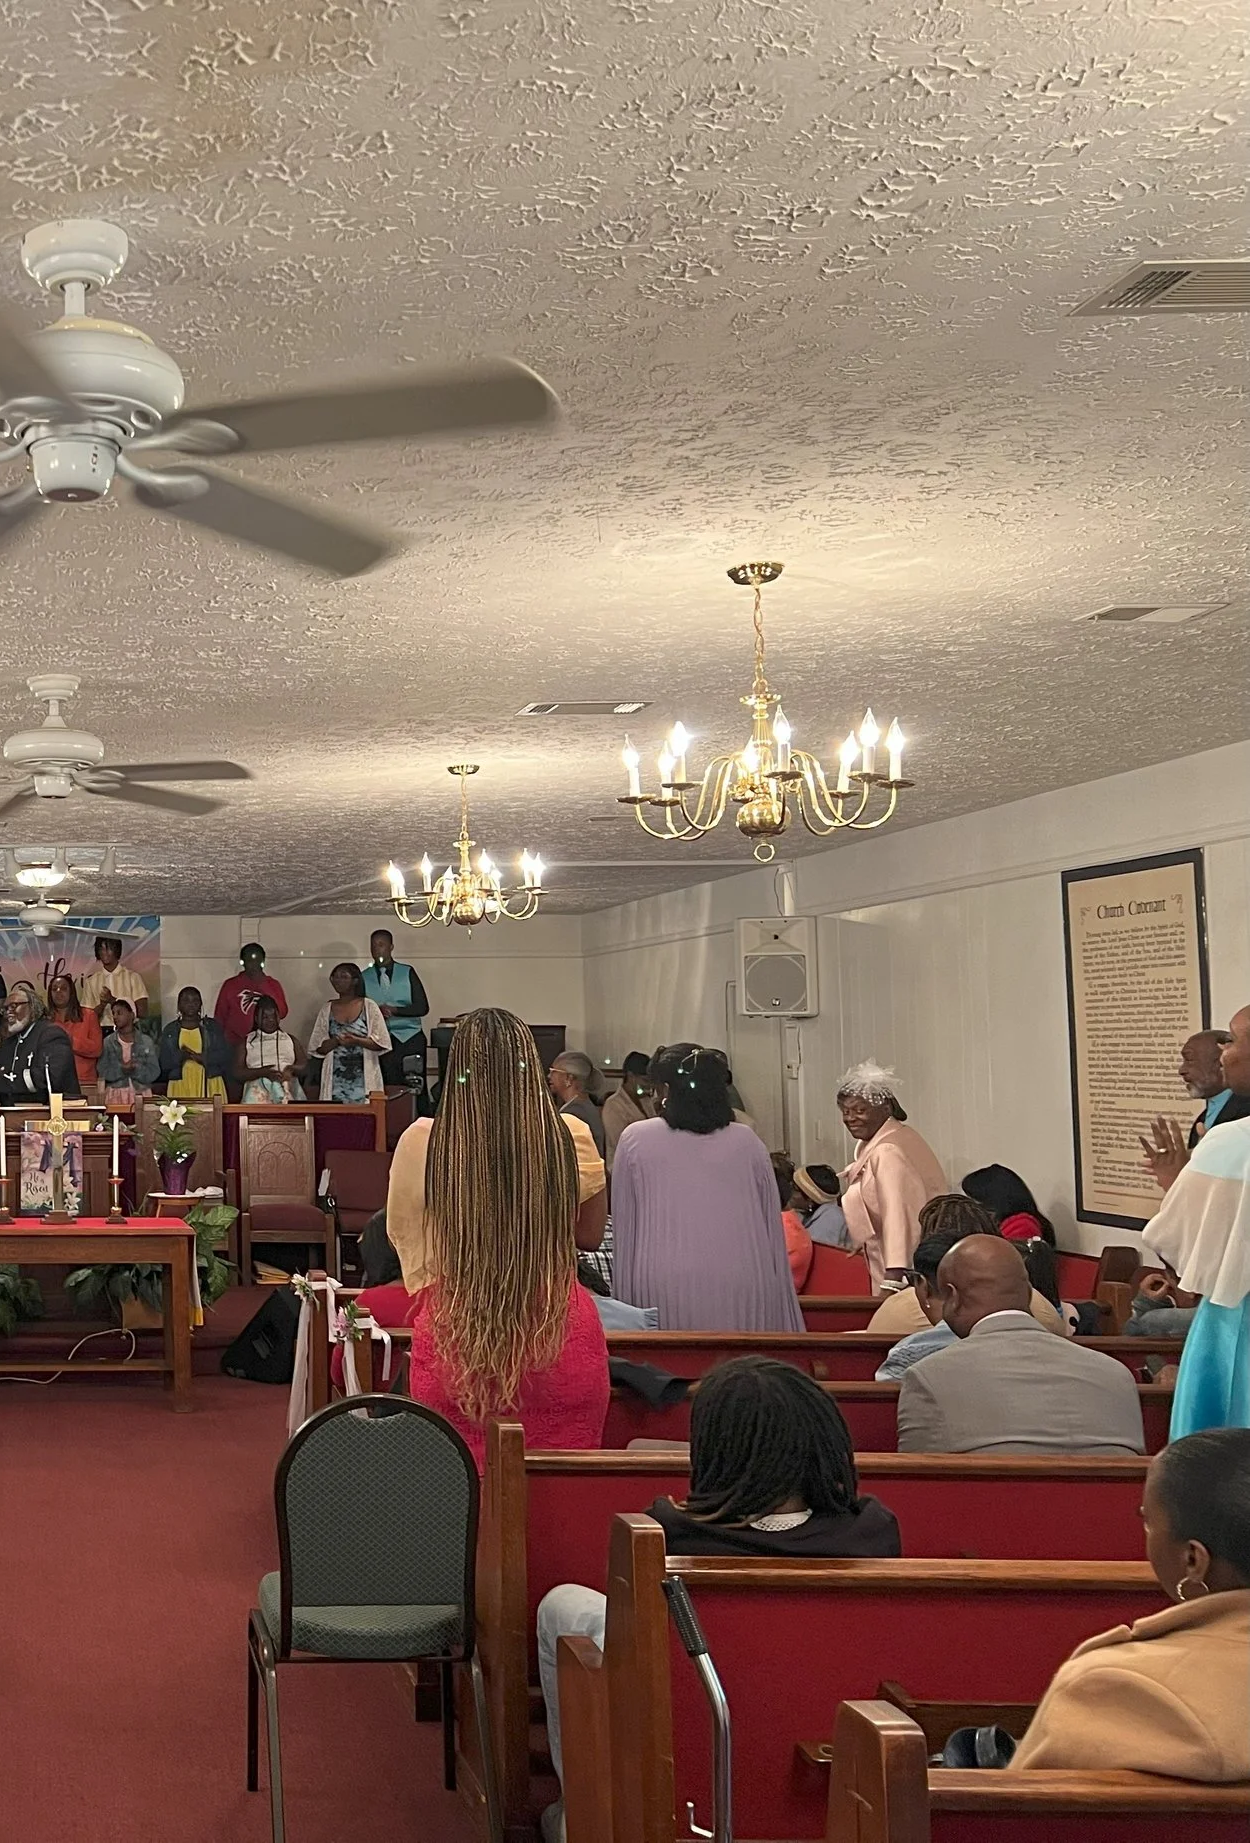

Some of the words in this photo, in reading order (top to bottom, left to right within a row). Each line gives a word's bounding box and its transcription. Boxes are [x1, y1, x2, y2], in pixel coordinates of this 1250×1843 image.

[1096, 903, 1125, 919] Church
[1128, 900, 1166, 916] Covenant
[23, 1181, 48, 1195] Risen
